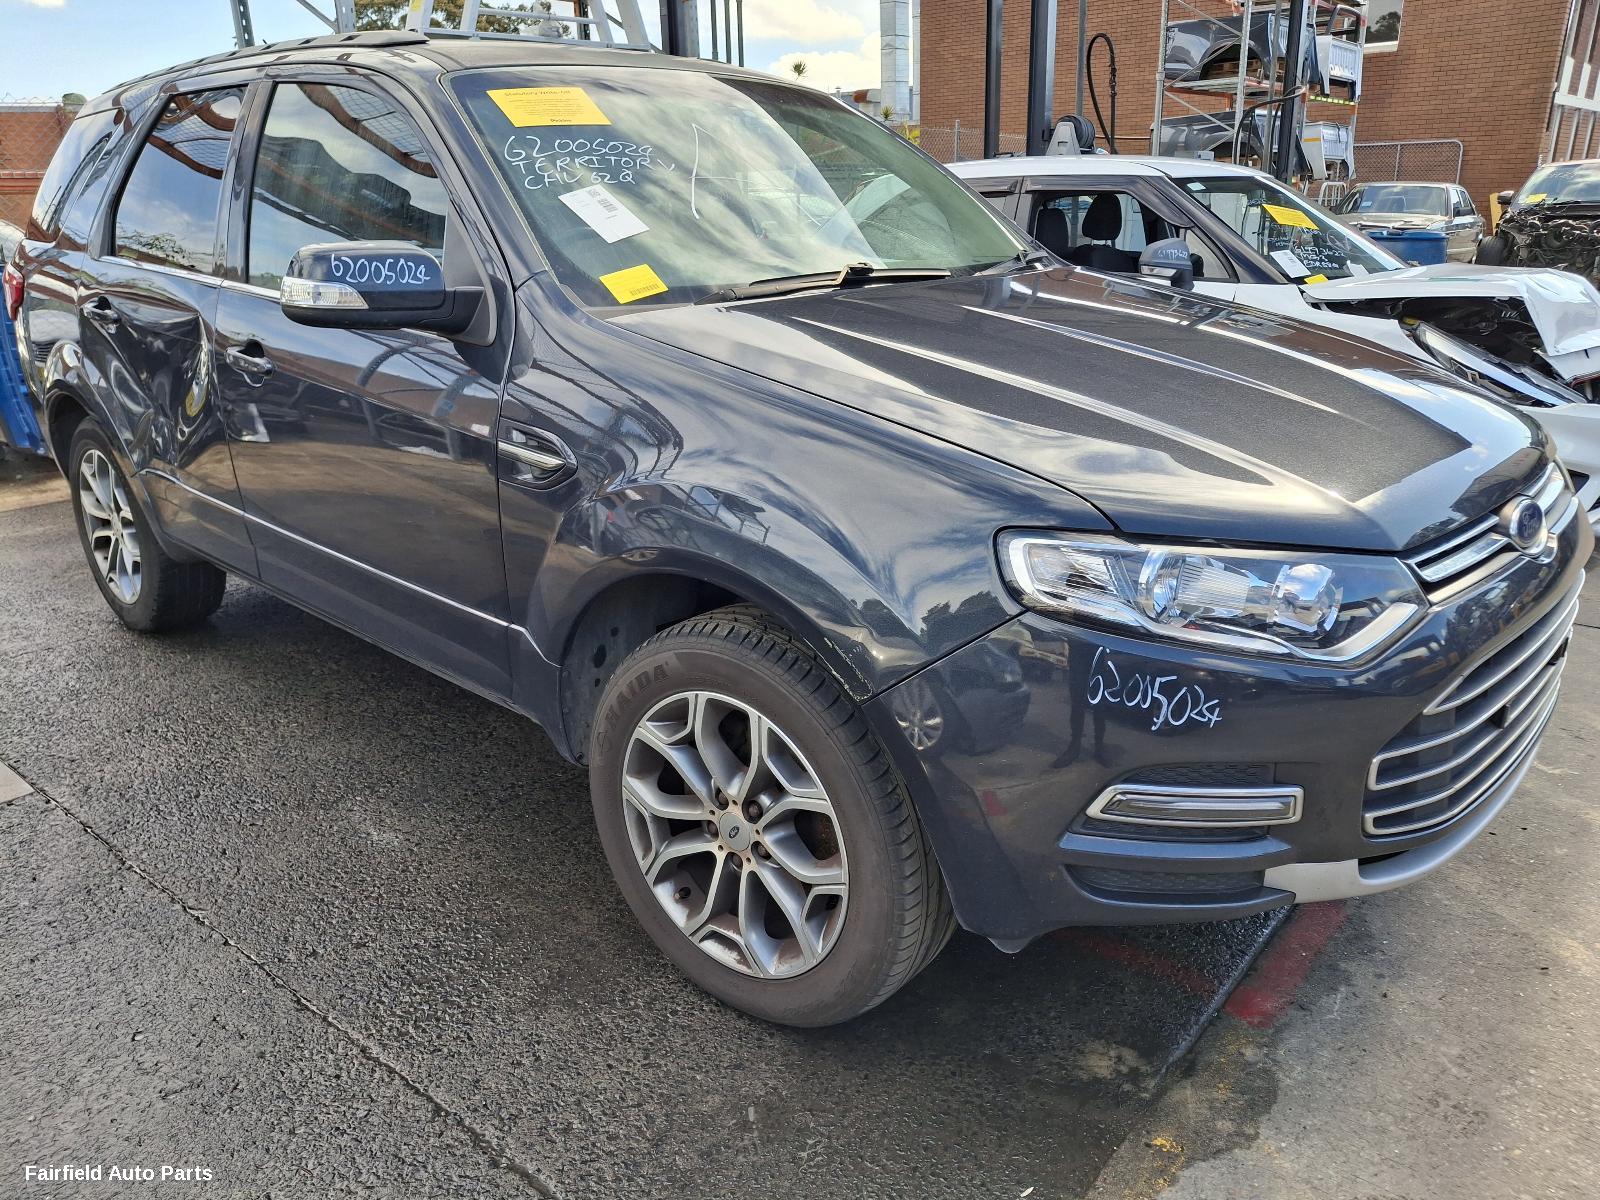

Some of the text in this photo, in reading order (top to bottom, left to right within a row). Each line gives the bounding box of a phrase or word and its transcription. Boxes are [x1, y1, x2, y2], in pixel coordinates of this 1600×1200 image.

[511, 155, 675, 175] TERRITORY
[331, 253, 431, 285] 62005024
[1087, 646, 1223, 731] 62005024
